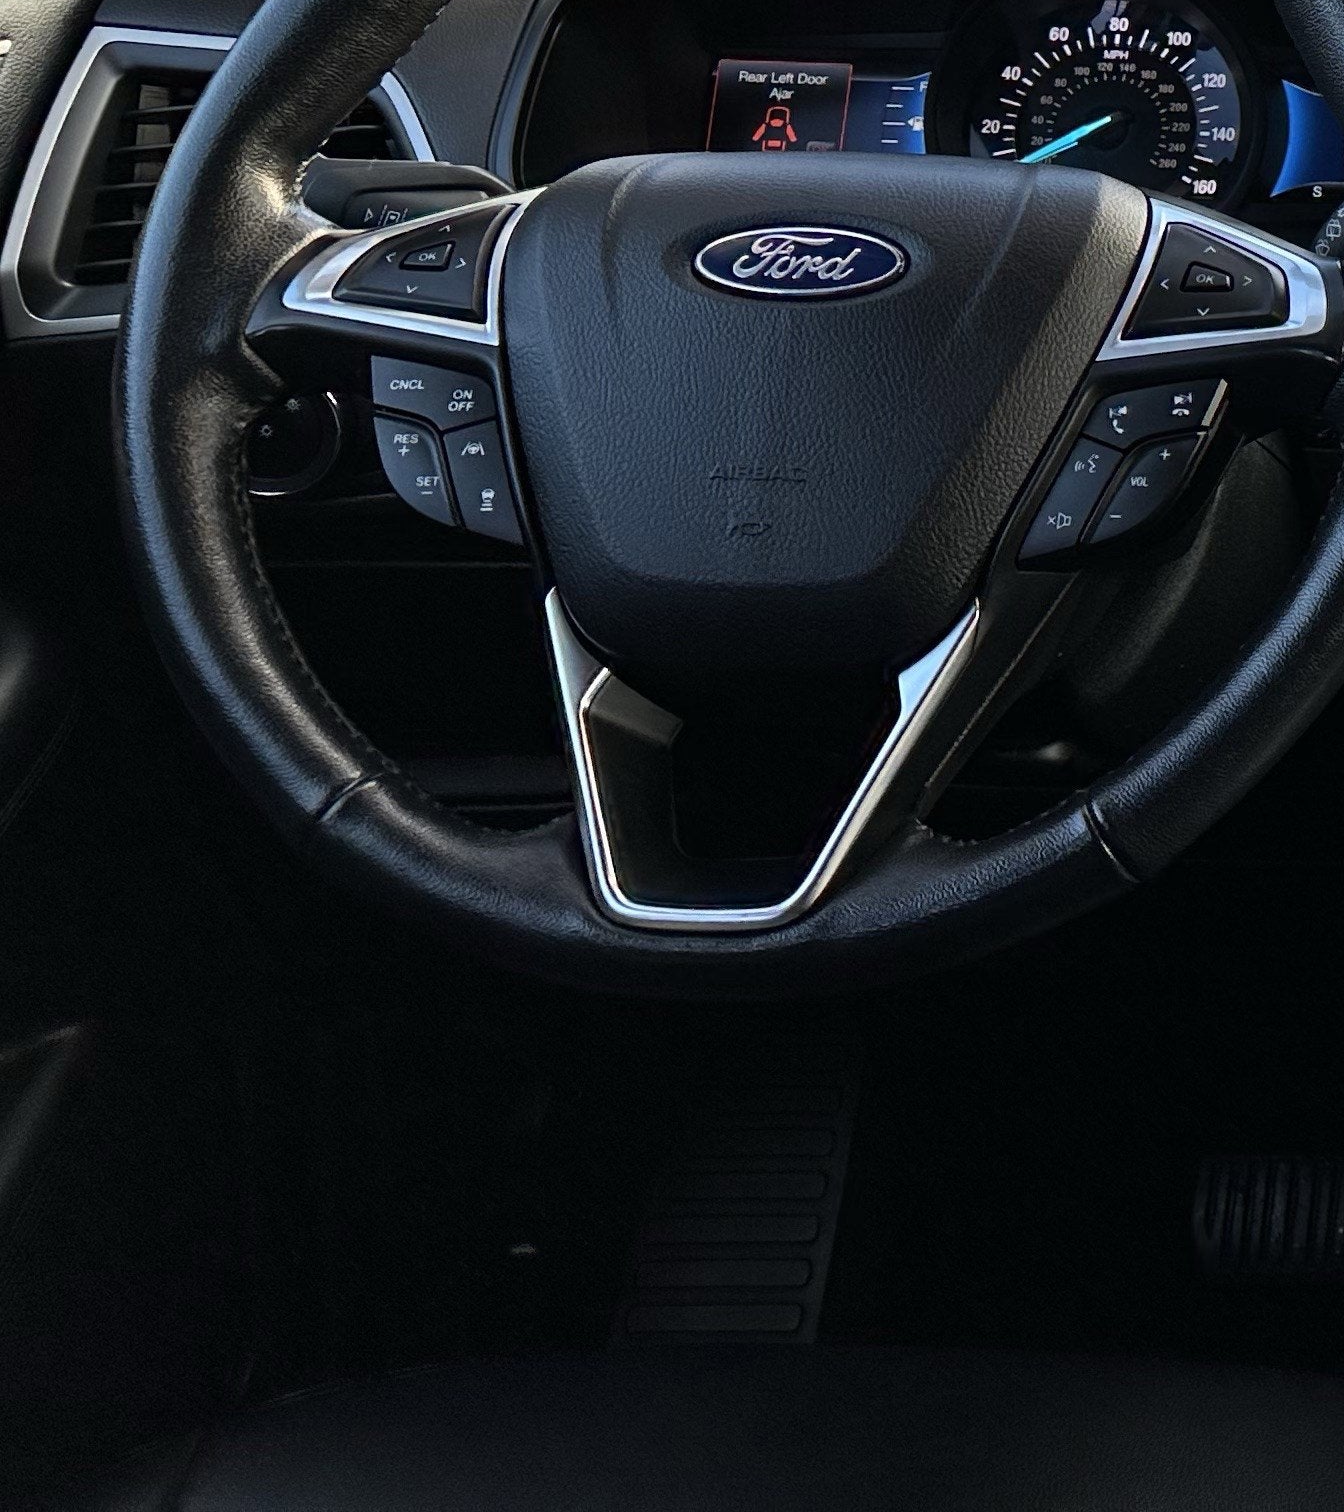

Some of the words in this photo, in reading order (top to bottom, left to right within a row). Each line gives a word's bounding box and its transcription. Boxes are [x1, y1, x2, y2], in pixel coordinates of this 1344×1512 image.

[1109, 17, 1129, 32] 80
[1049, 27, 1070, 41] 60
[1166, 31, 1191, 46] 100
[1103, 49, 1129, 60] MPH
[738, 70, 767, 84] Rear
[771, 71, 795, 85] Left
[797, 72, 829, 85] Door
[1001, 66, 1021, 81] 40
[1203, 73, 1227, 88] 120
[769, 87, 795, 102] Ajar
[981, 119, 1001, 134] 20
[1212, 127, 1236, 142] 140
[1192, 179, 1217, 195] 160
[1312, 185, 1323, 198] S
[418, 252, 436, 262] OK
[732, 233, 862, 281] Ford
[1196, 273, 1215, 285] OK
[390, 379, 425, 390] CNCL
[453, 389, 473, 400] ON
[447, 401, 475, 412] OFF
[393, 433, 419, 445] RES
[415, 476, 440, 487] SET
[1130, 476, 1149, 488] VOL
